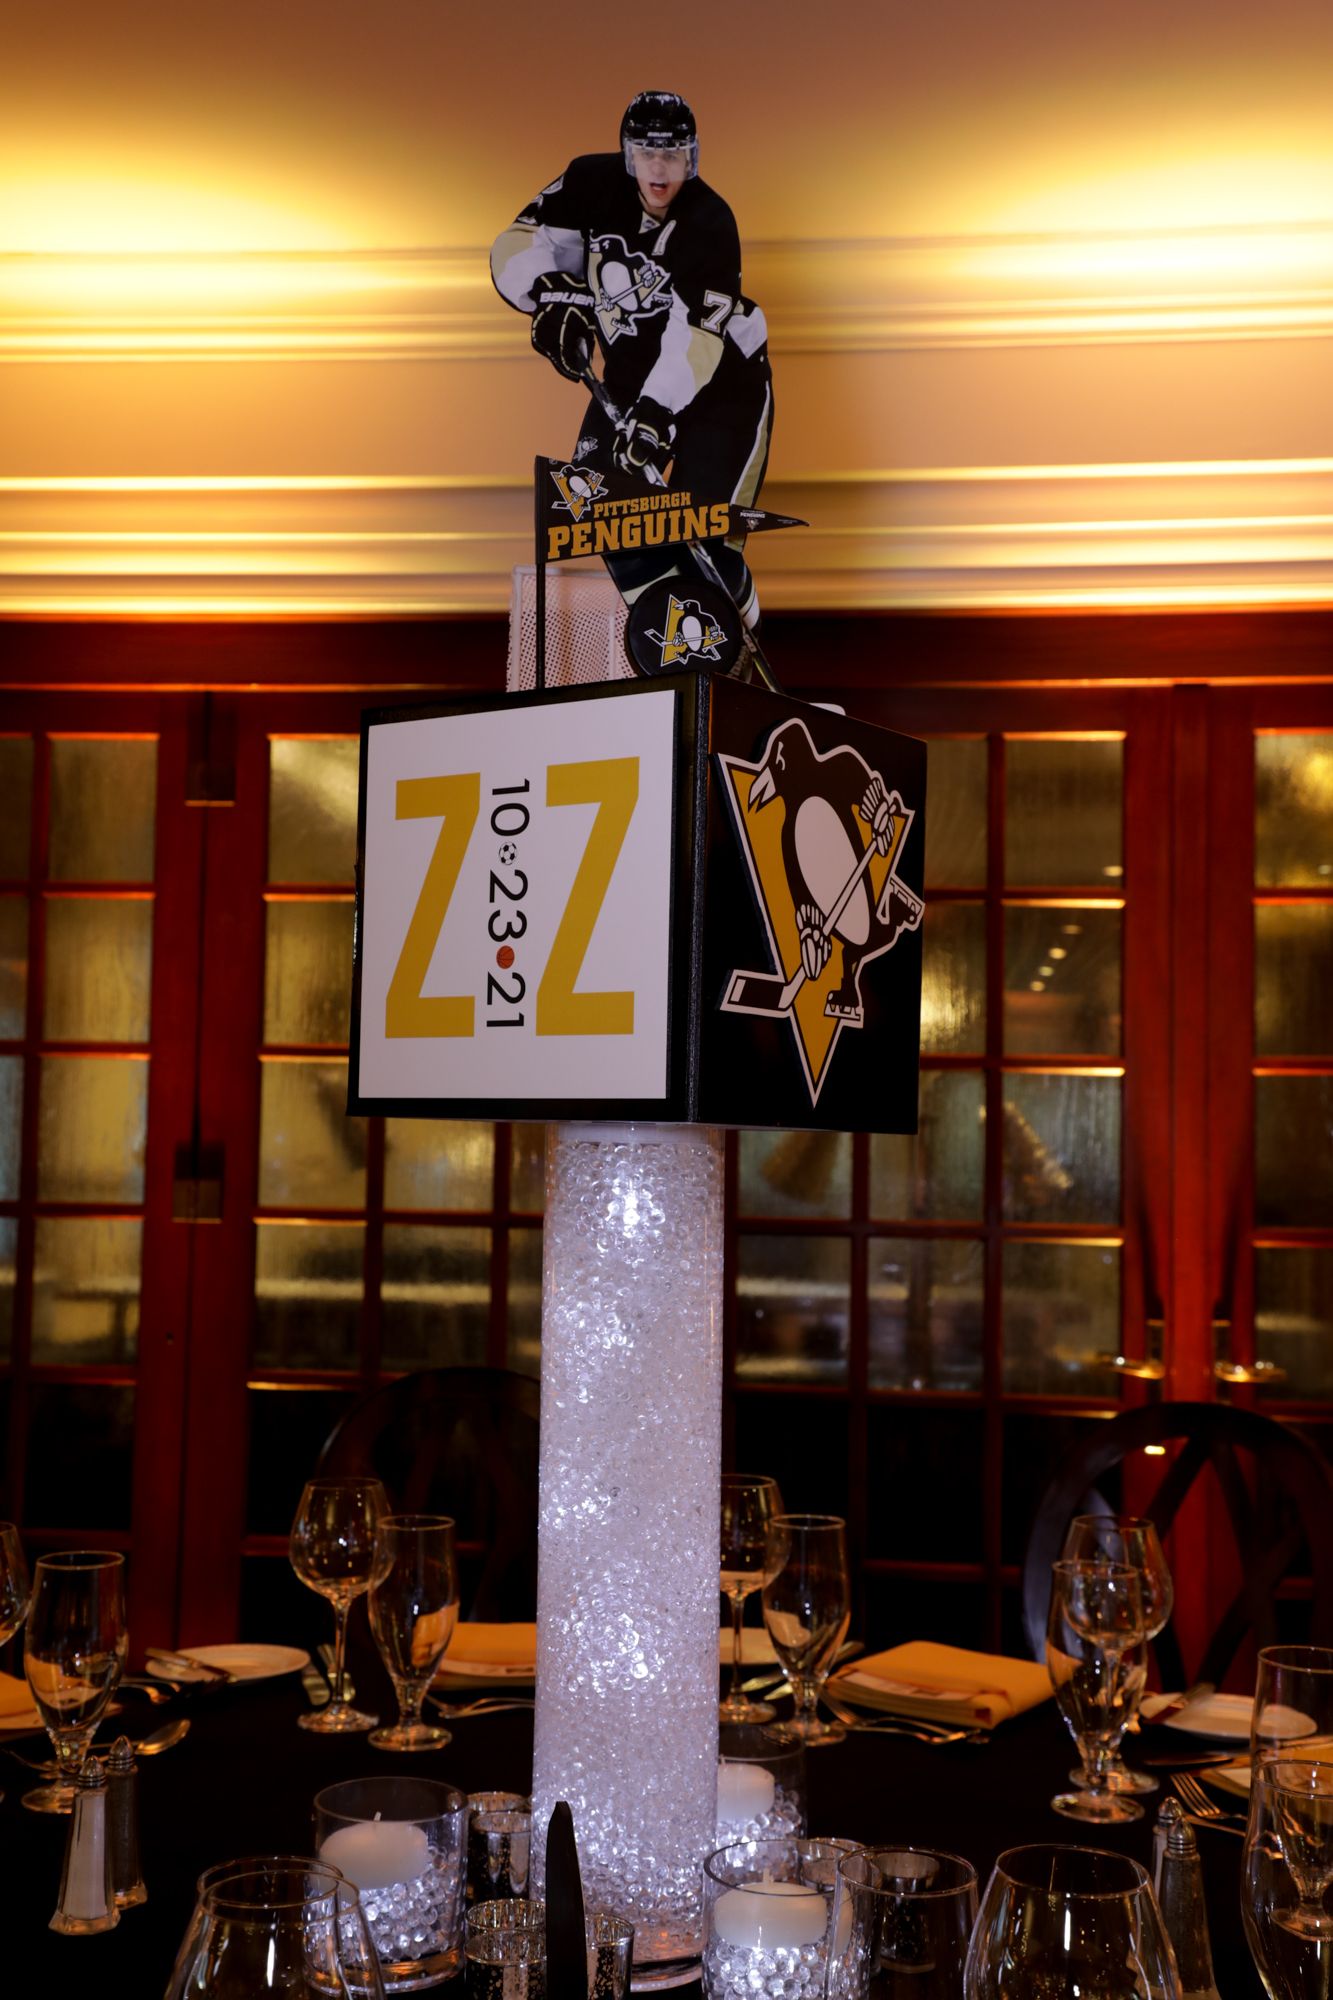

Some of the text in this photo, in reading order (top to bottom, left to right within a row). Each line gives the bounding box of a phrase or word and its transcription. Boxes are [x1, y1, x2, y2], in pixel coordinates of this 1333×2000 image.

[547, 503, 730, 559] PENGUINS
[593, 492, 691, 518] PITTSBURGH
[385, 772, 480, 1038] Z
[486, 778, 530, 1027] 10 23 21
[536, 756, 640, 1036] Z
